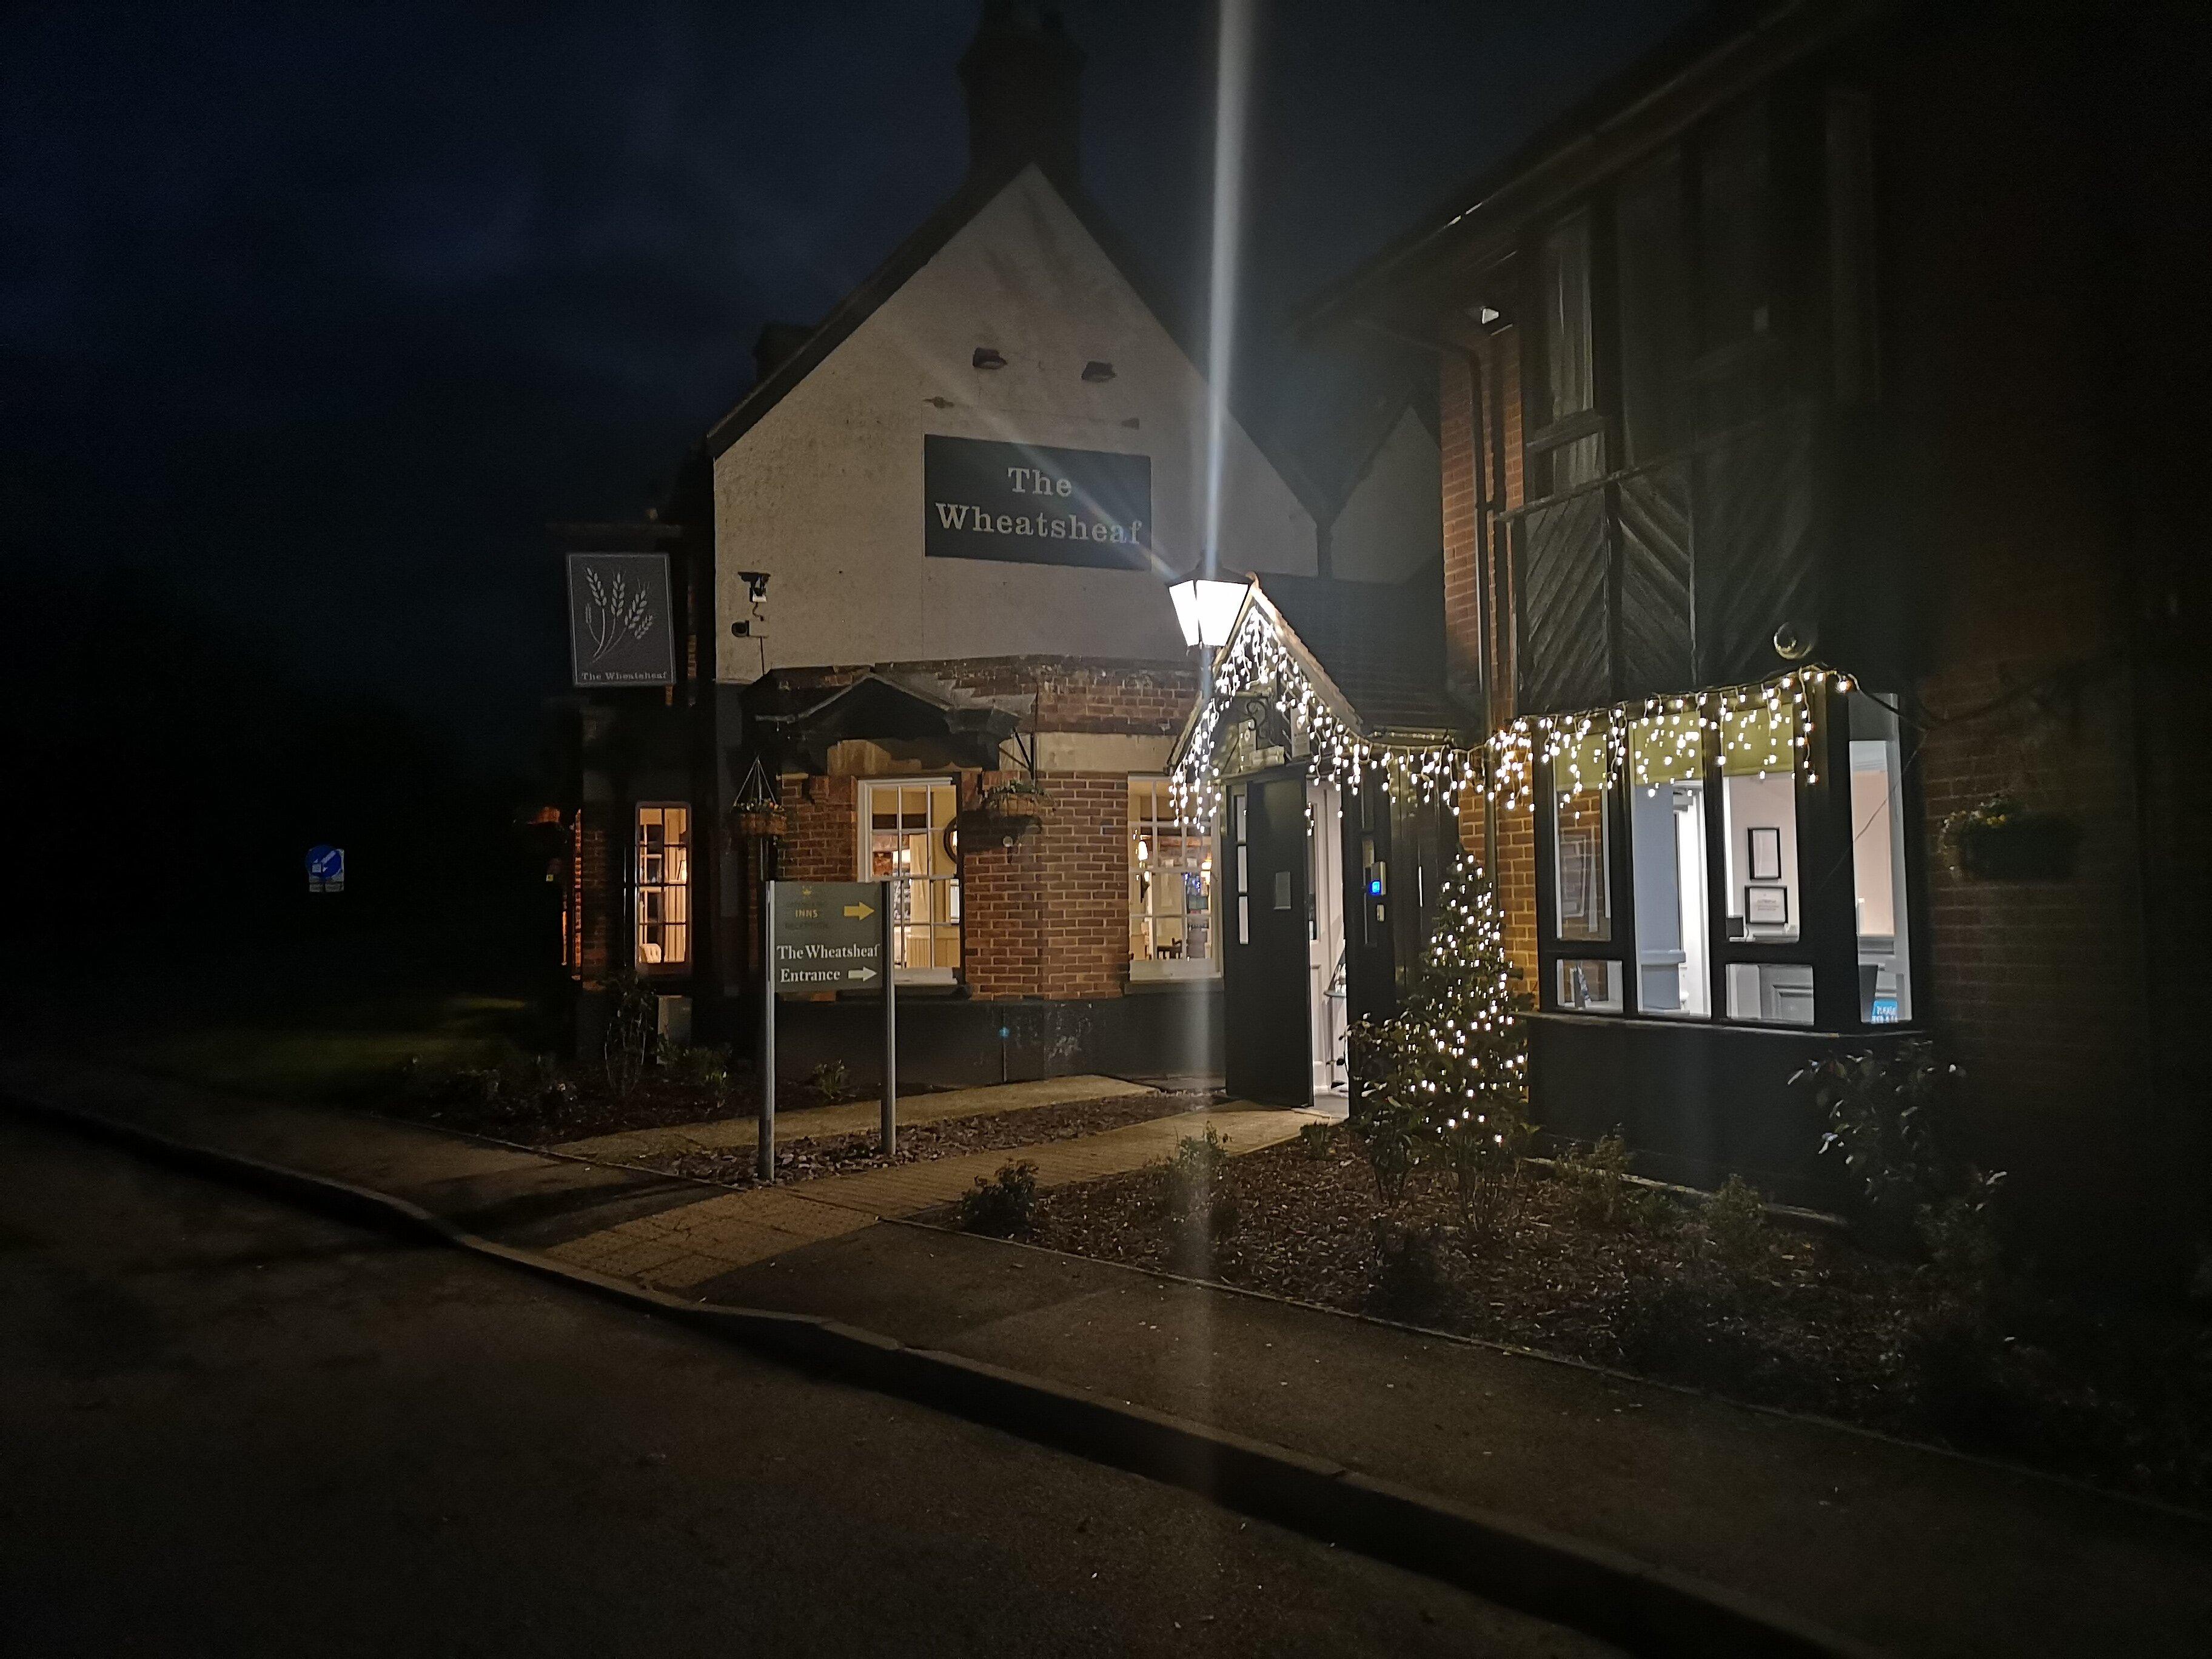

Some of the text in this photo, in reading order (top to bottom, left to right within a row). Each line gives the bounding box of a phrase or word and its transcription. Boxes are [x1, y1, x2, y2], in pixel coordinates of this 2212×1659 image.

[1008, 467, 1072, 497] The
[935, 503, 1142, 545] Wheatsheaf
[777, 943, 880, 959] The Wheatsheaf
[780, 968, 840, 982] Entrance
